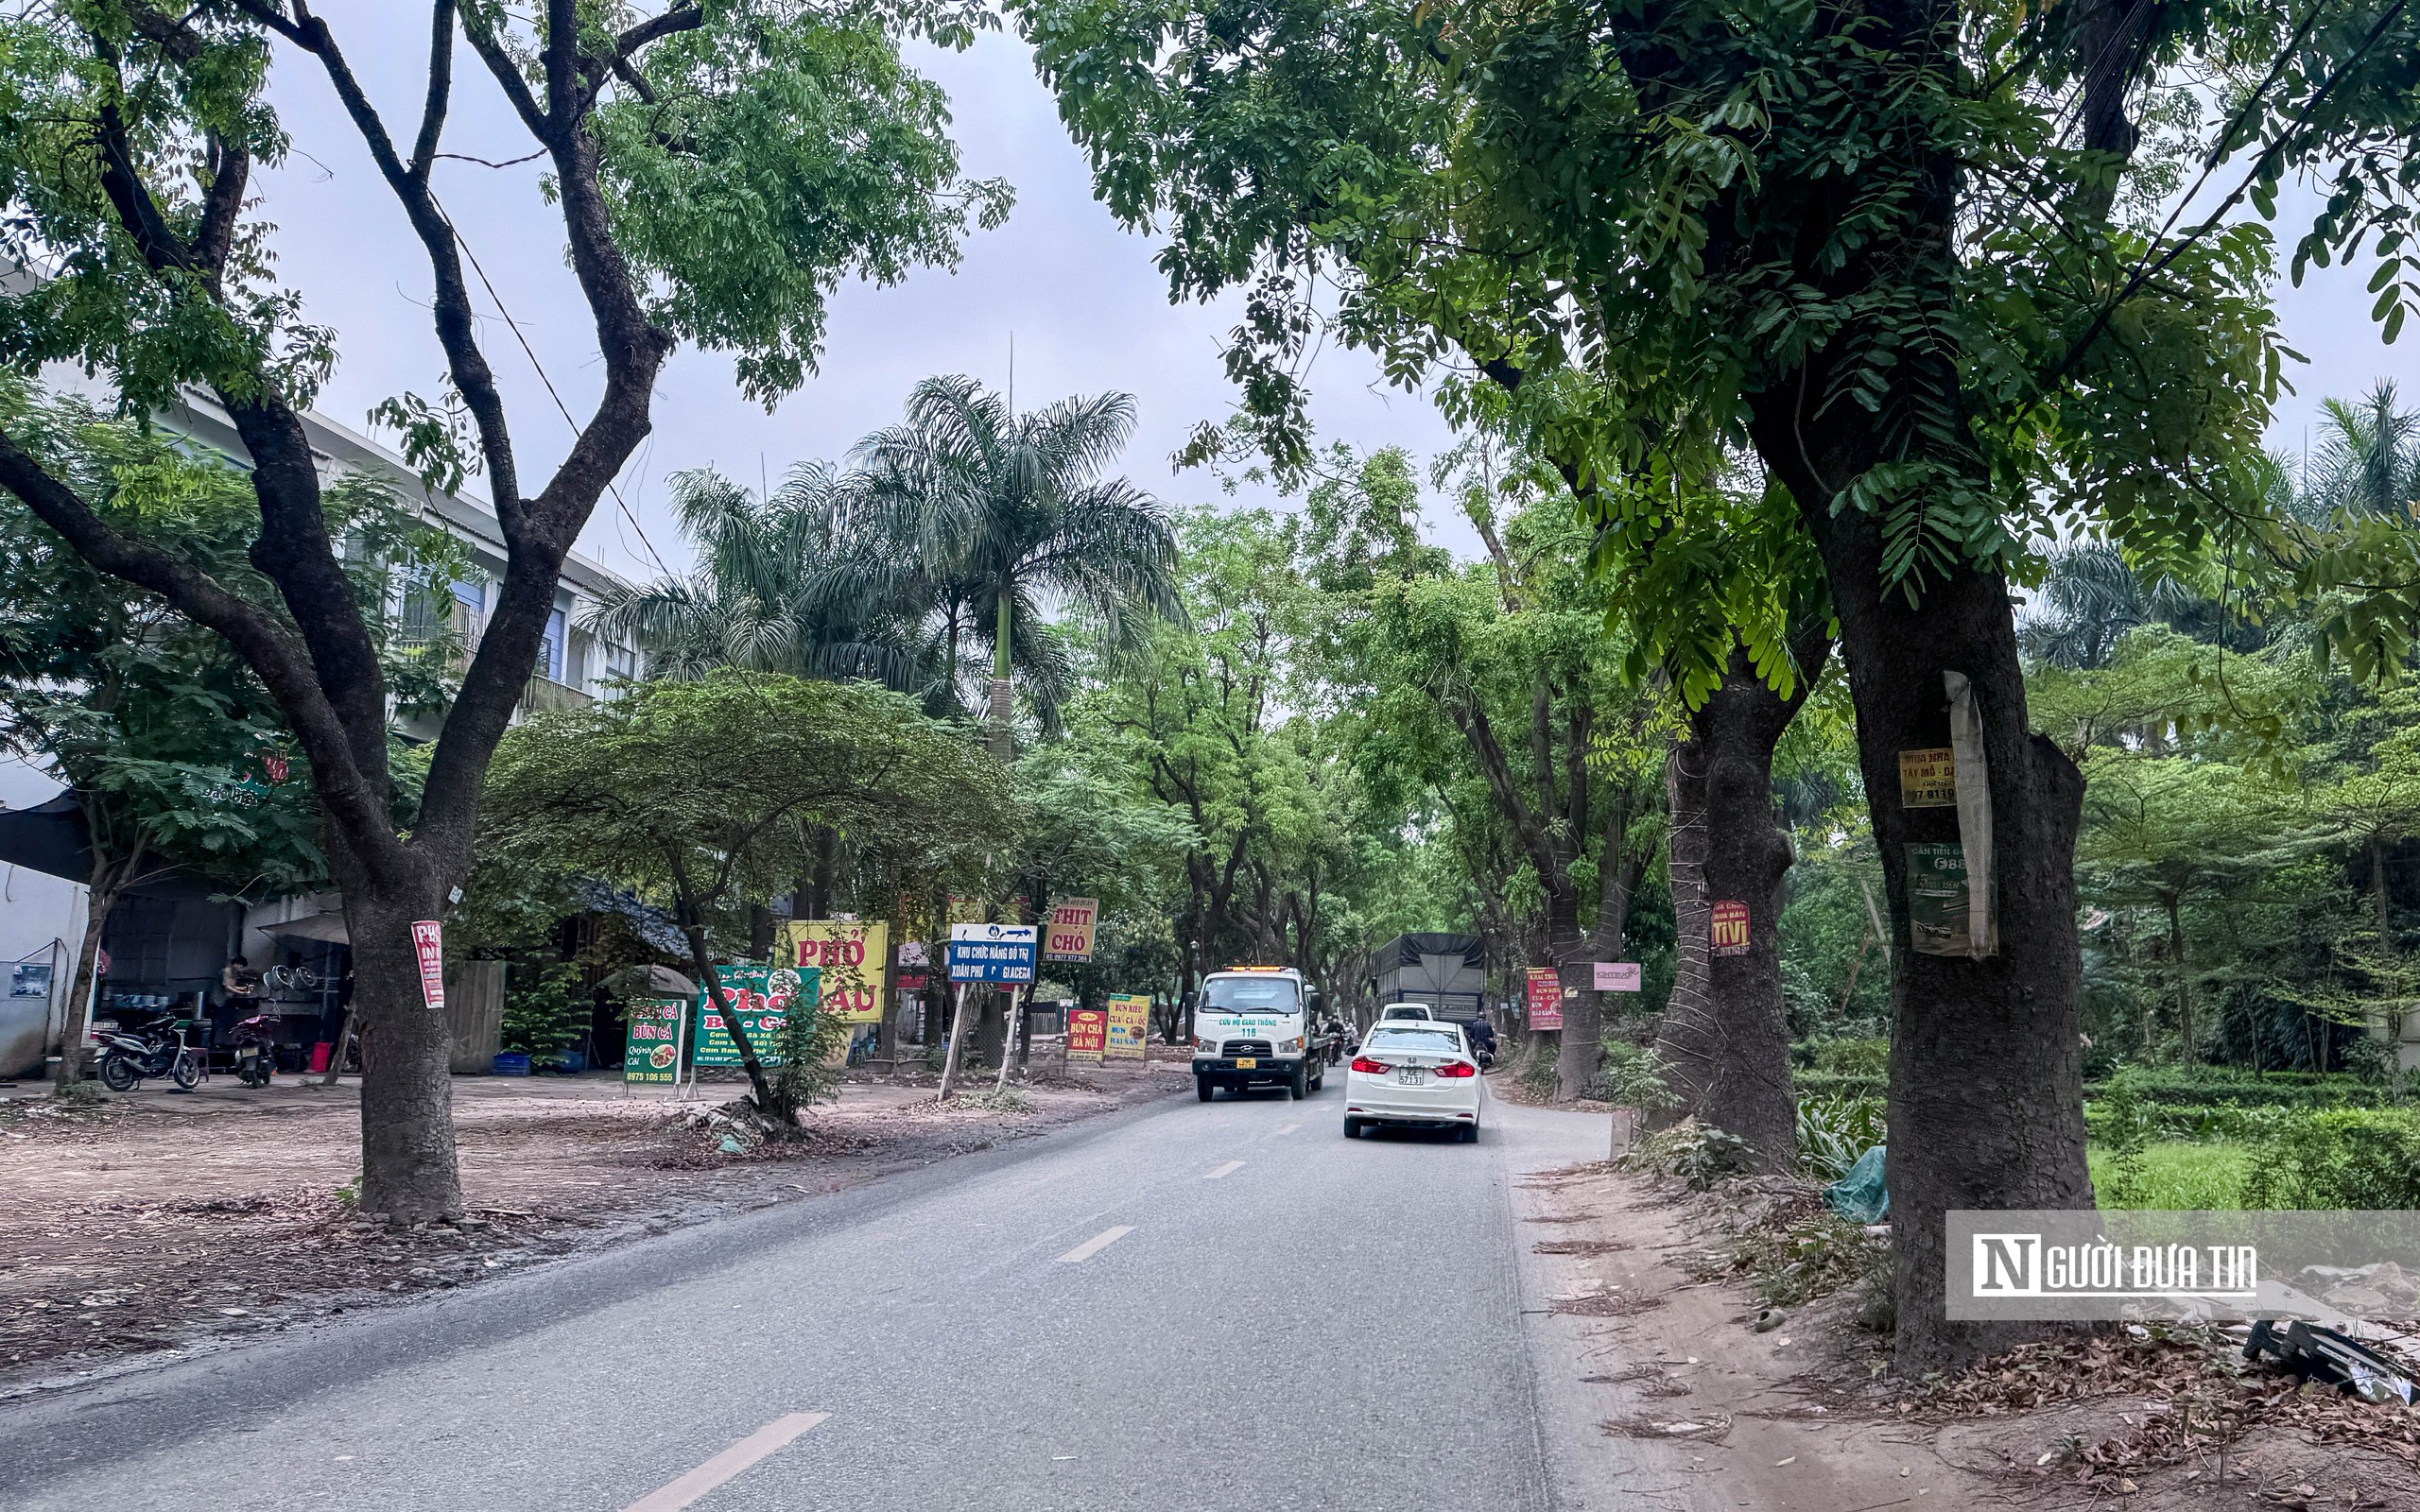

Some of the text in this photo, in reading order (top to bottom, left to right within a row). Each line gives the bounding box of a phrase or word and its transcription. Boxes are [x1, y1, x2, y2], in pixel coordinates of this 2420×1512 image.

[798, 929, 867, 967] PHỞ
[1051, 930, 1086, 952] CHÓ
[957, 944, 971, 958] KHU
[971, 943, 989, 959] CHỨC
[989, 945, 1008, 960] NĂNG
[951, 963, 970, 978] XUÂN
[663, 1003, 678, 1020] CÁ
[632, 1022, 673, 1040] BÚN CÁ
[1070, 1021, 1103, 1035] BÚN CHẢ
[1257, 1019, 1277, 1027] THÔNG
[1072, 1035, 1098, 1050] HÀ NỘI
